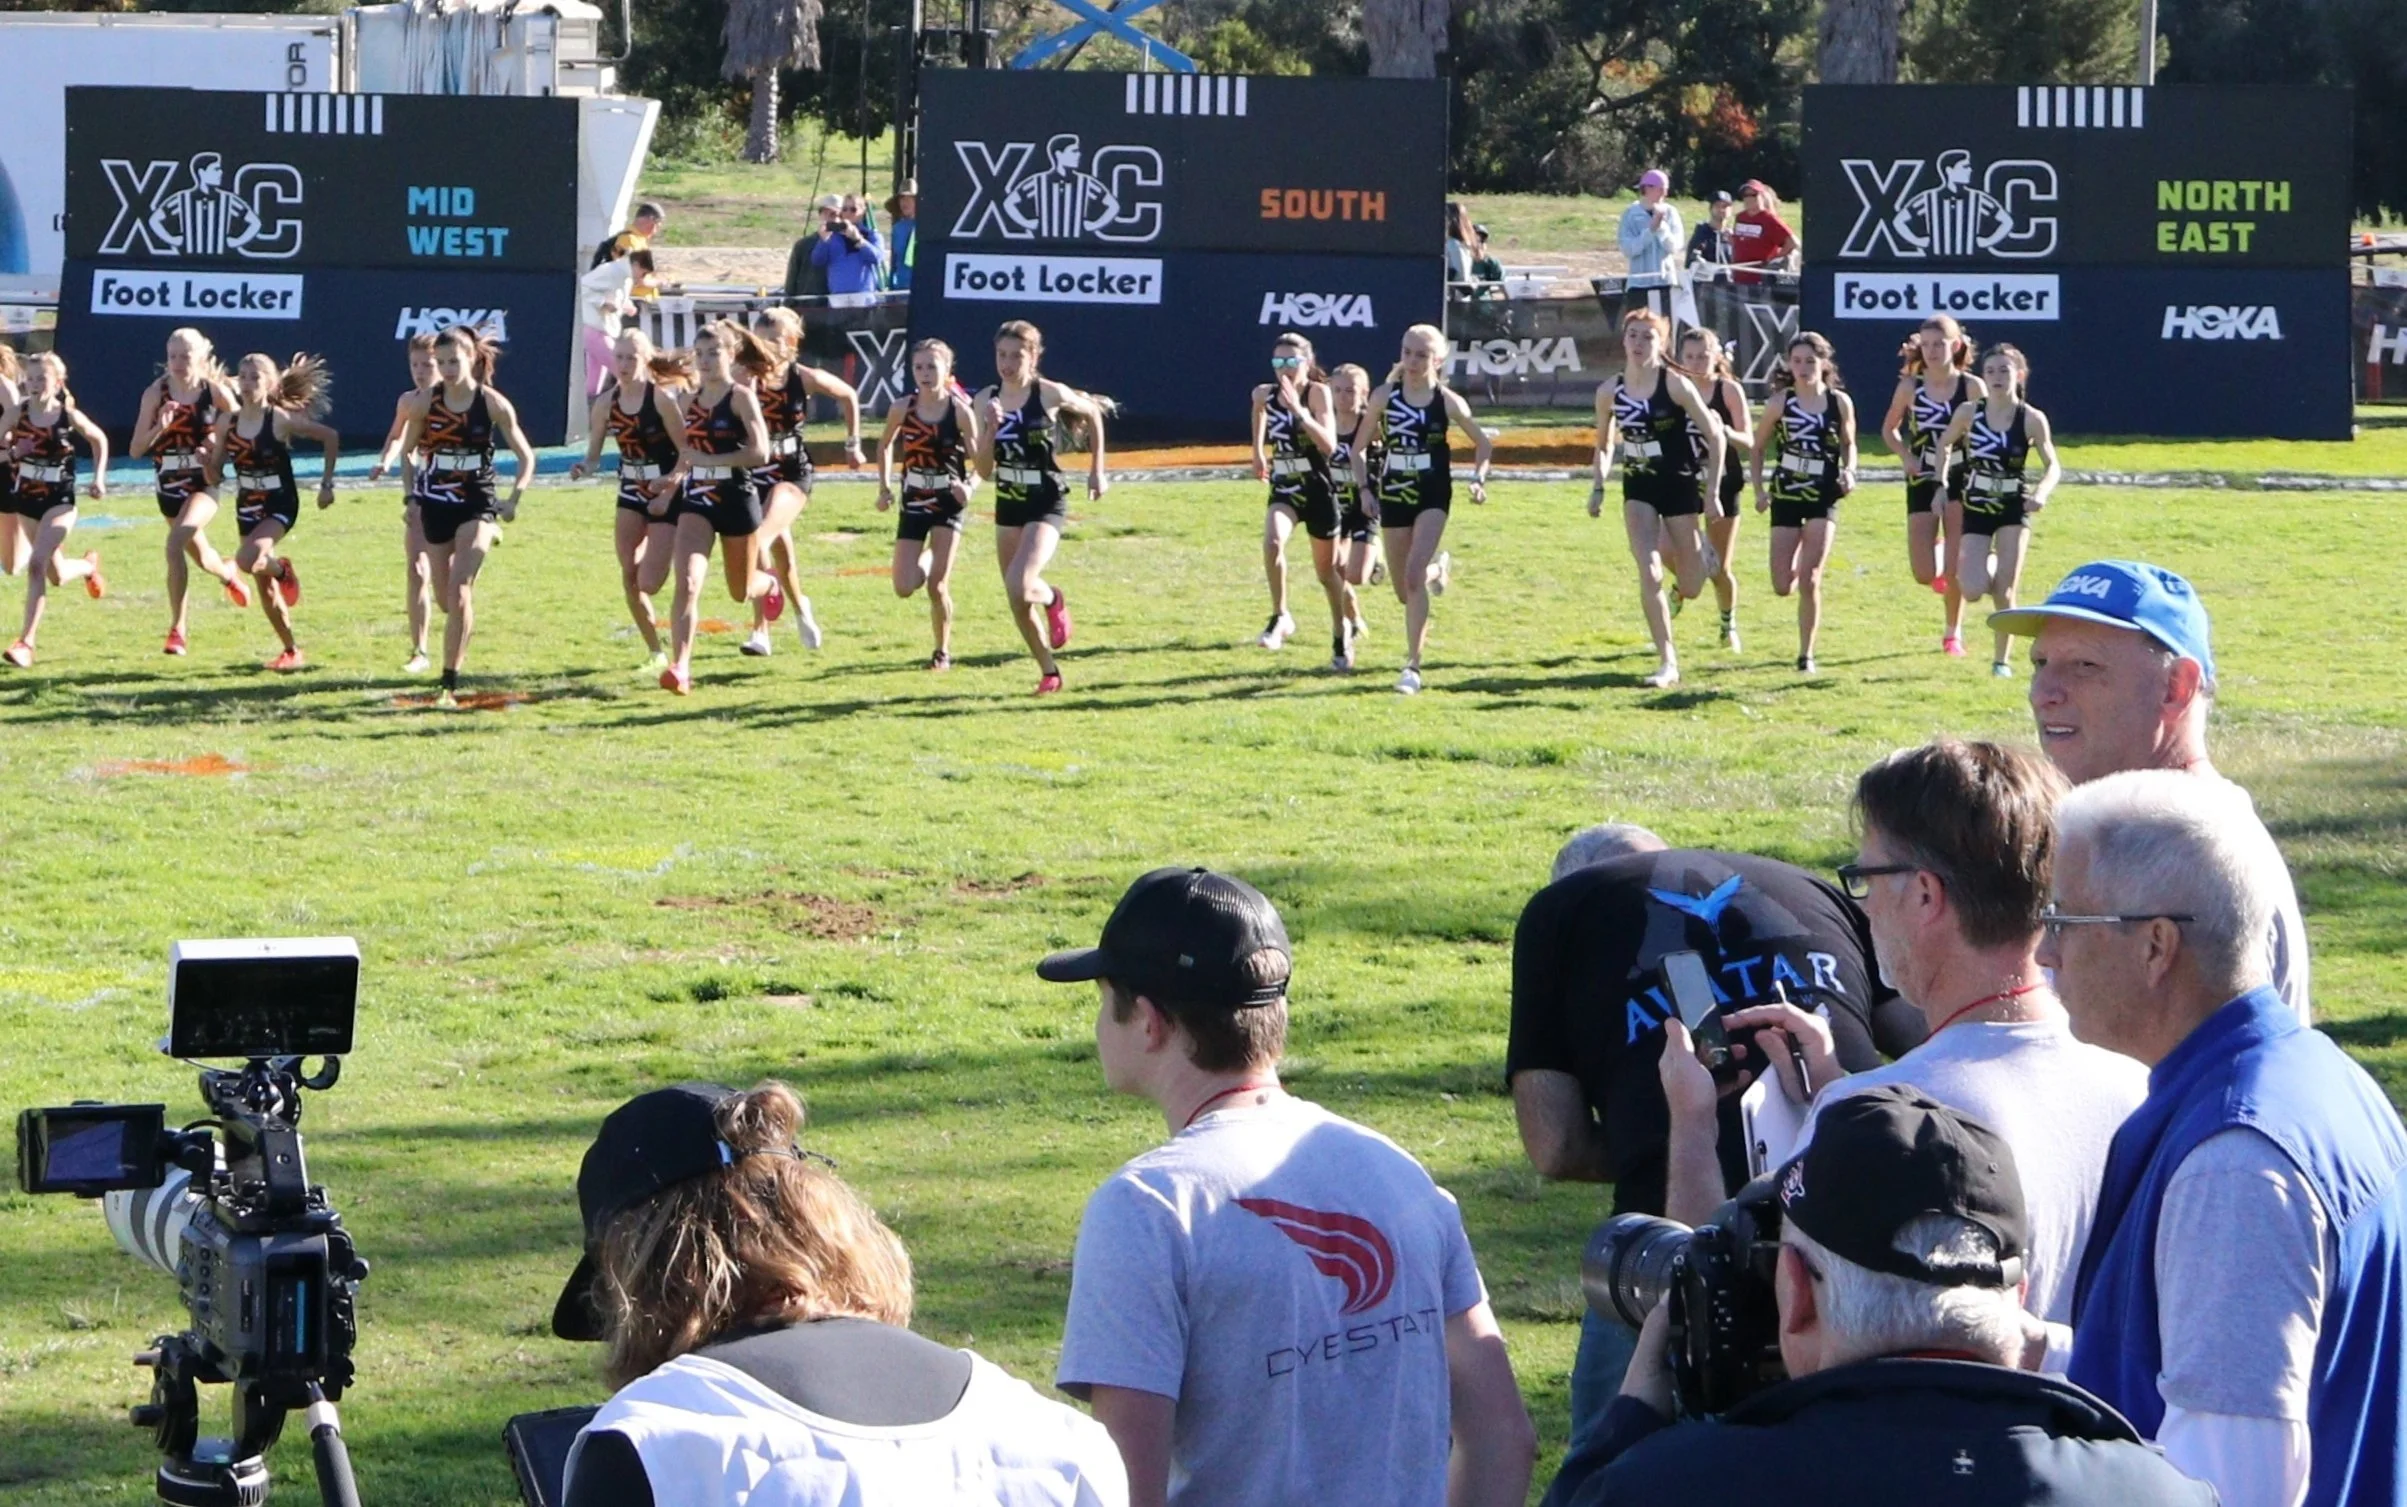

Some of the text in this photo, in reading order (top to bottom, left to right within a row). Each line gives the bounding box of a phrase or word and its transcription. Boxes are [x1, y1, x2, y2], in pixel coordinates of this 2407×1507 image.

[287, 42, 306, 92] OR
[408, 186, 475, 218] MID
[1260, 188, 1387, 222] SOUTH
[2157, 180, 2291, 213] NORTH
[407, 226, 509, 258] WEST
[2157, 221, 2256, 254] EAST
[101, 278, 294, 311] Foot Locker
[953, 261, 1153, 295] Foot Locker
[1259, 291, 1375, 328] HOKA
[1844, 281, 2050, 312] Foot Locker
[2161, 305, 2282, 340] HOKA
[1443, 336, 1582, 376] HOKA
[2053, 574, 2113, 599] OKA
